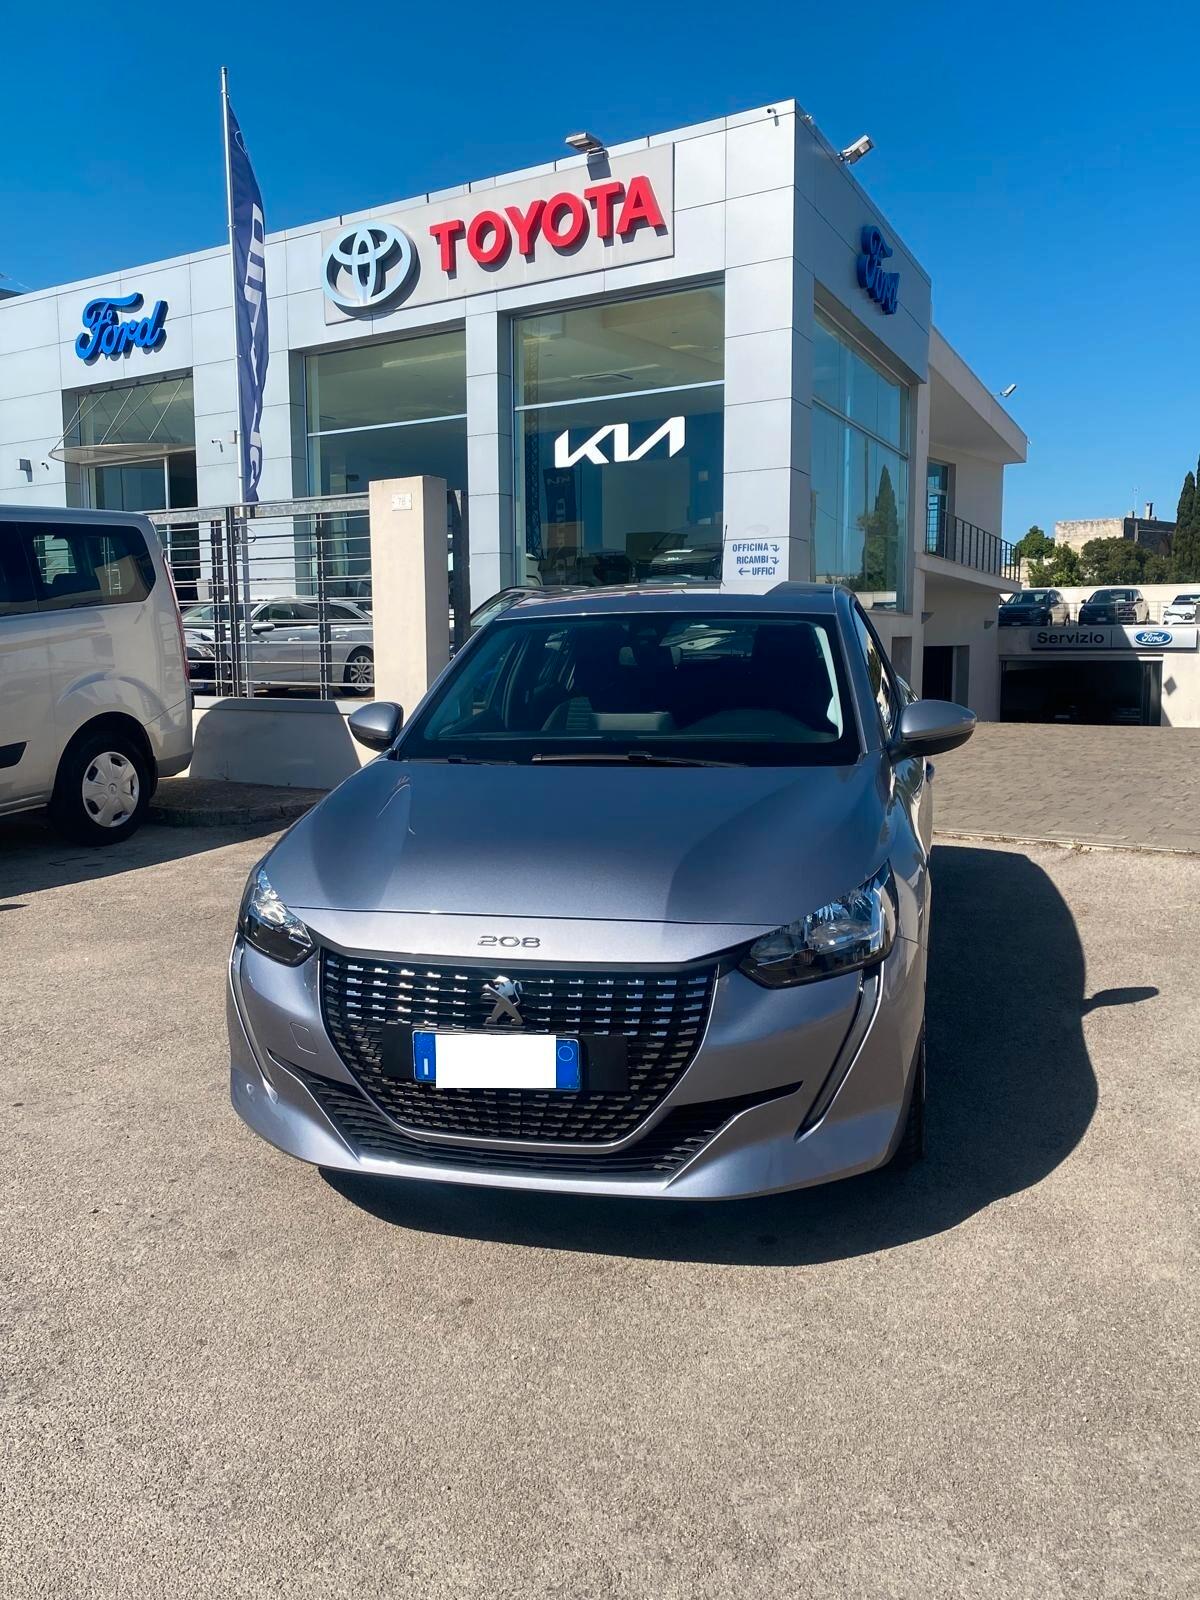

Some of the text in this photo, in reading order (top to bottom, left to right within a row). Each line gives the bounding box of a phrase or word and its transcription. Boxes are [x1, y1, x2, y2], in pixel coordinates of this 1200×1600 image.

[429, 175, 666, 272] TOYOTA
[857, 225, 899, 315] Ford
[76, 292, 168, 360] Ford
[554, 416, 685, 469] KIA
[732, 543, 769, 552] OFFICINA
[736, 555, 769, 565] RICAMBI
[752, 567, 776, 576] UFFICI
[1037, 631, 1105, 644] Servizio
[478, 935, 541, 948] 208
